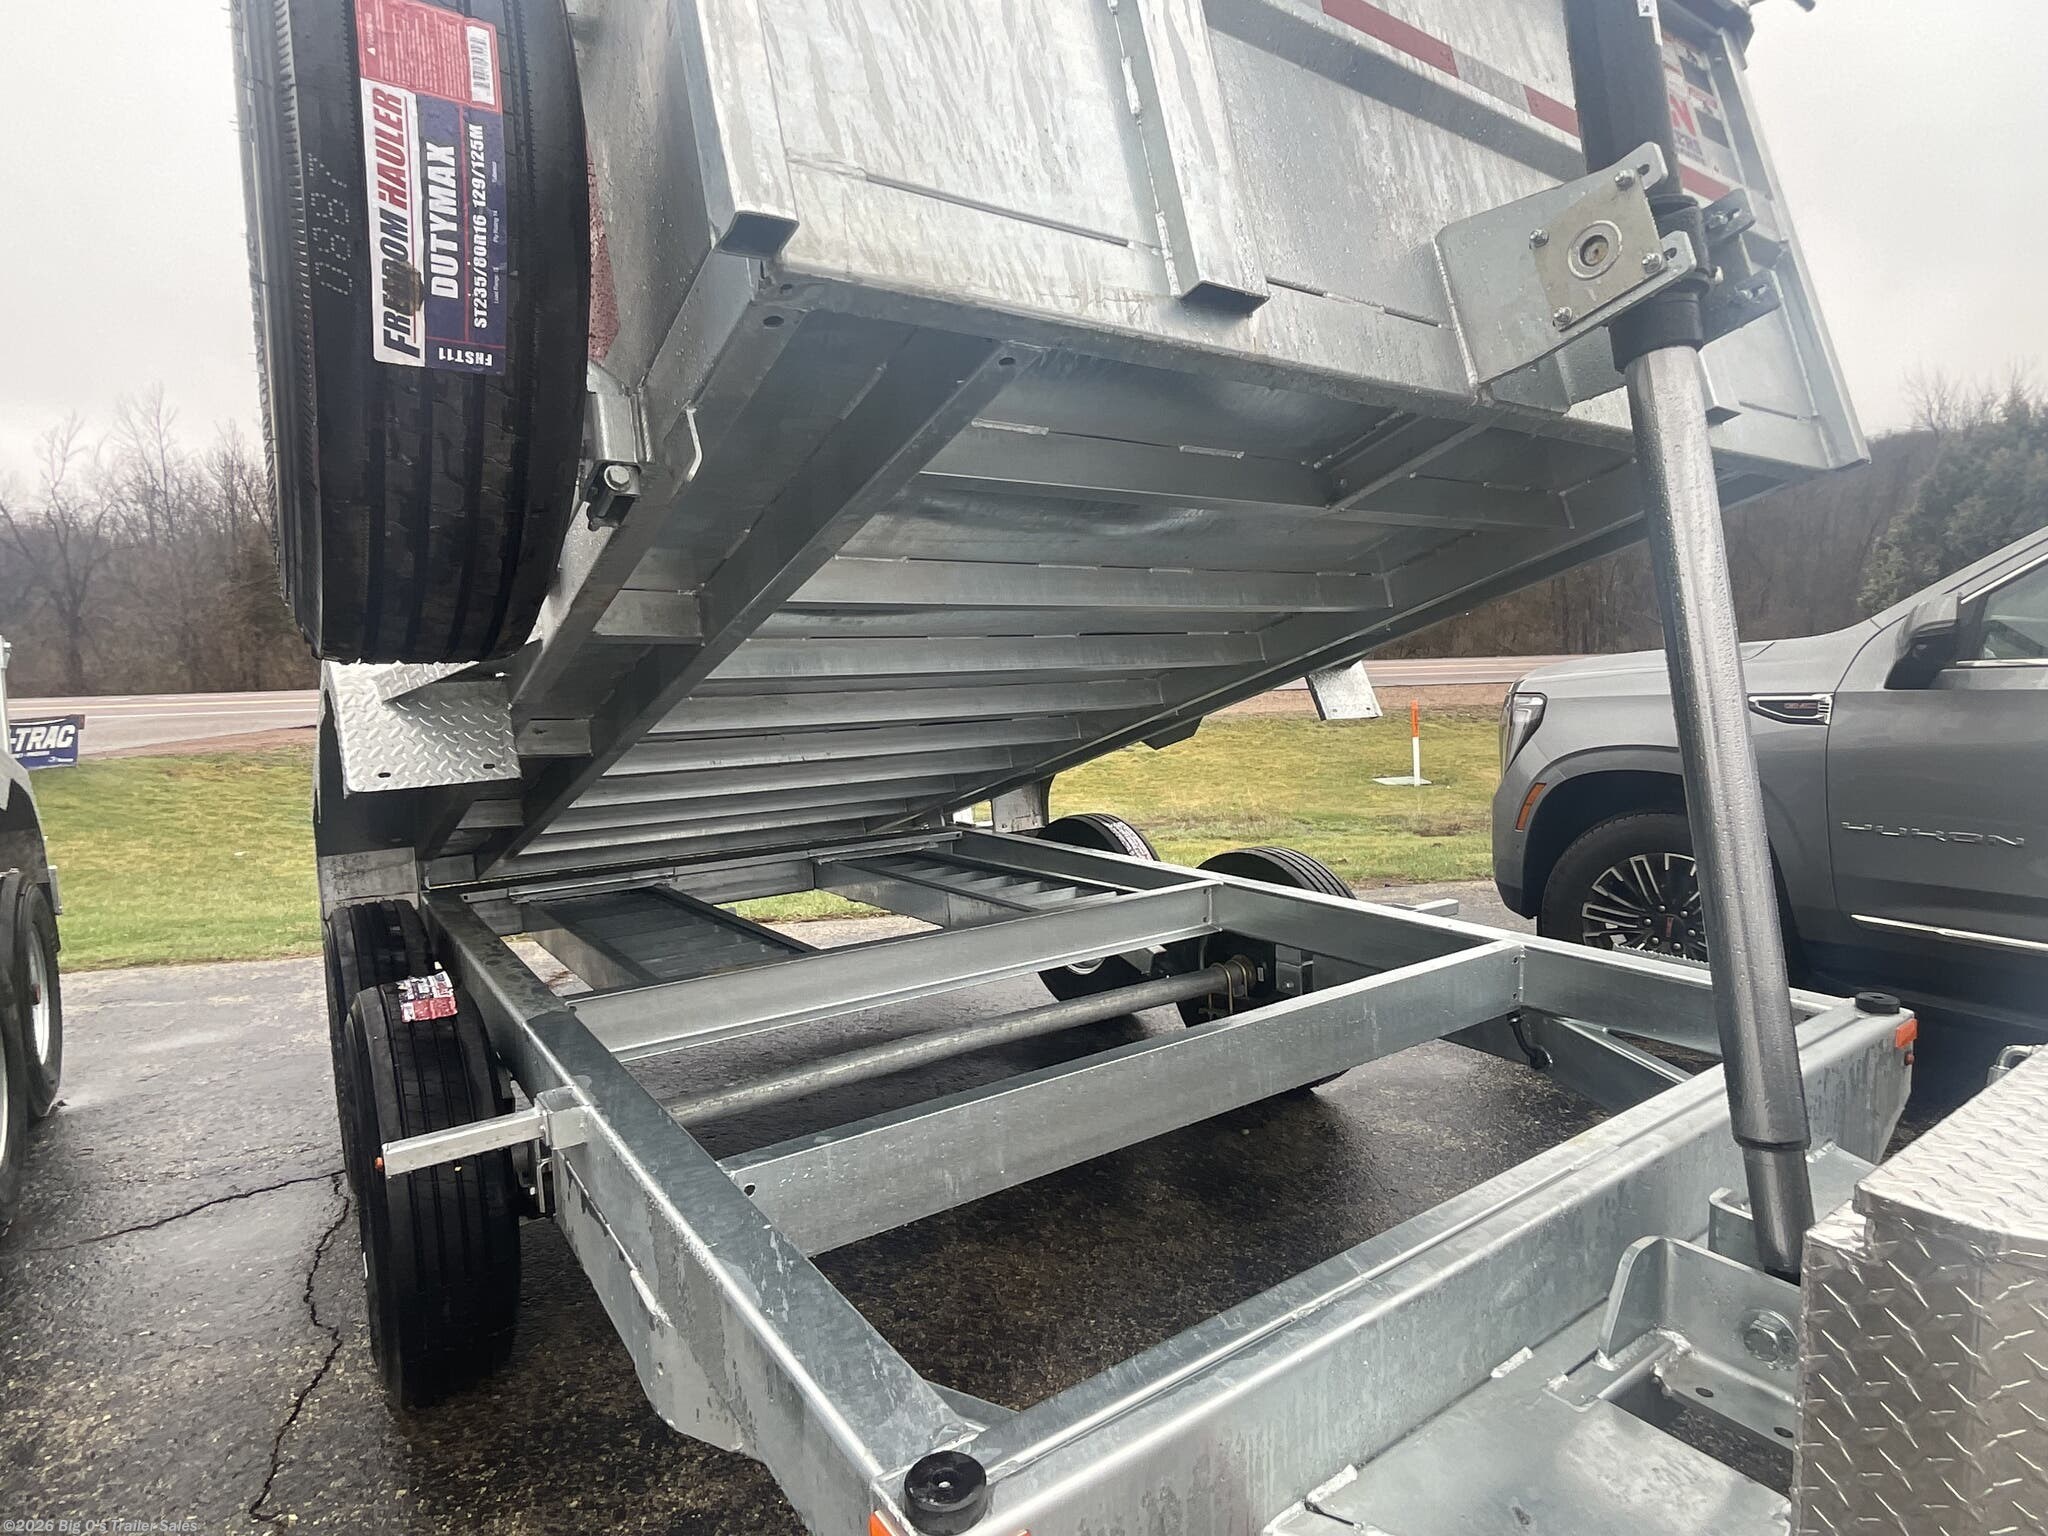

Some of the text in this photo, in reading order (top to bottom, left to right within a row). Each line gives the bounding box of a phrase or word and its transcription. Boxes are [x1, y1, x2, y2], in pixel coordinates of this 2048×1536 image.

[372, 87, 420, 359] FRDOM HAULER
[426, 142, 459, 299] DUTYMAX
[468, 124, 488, 329] ST235/80R16 129/125M
